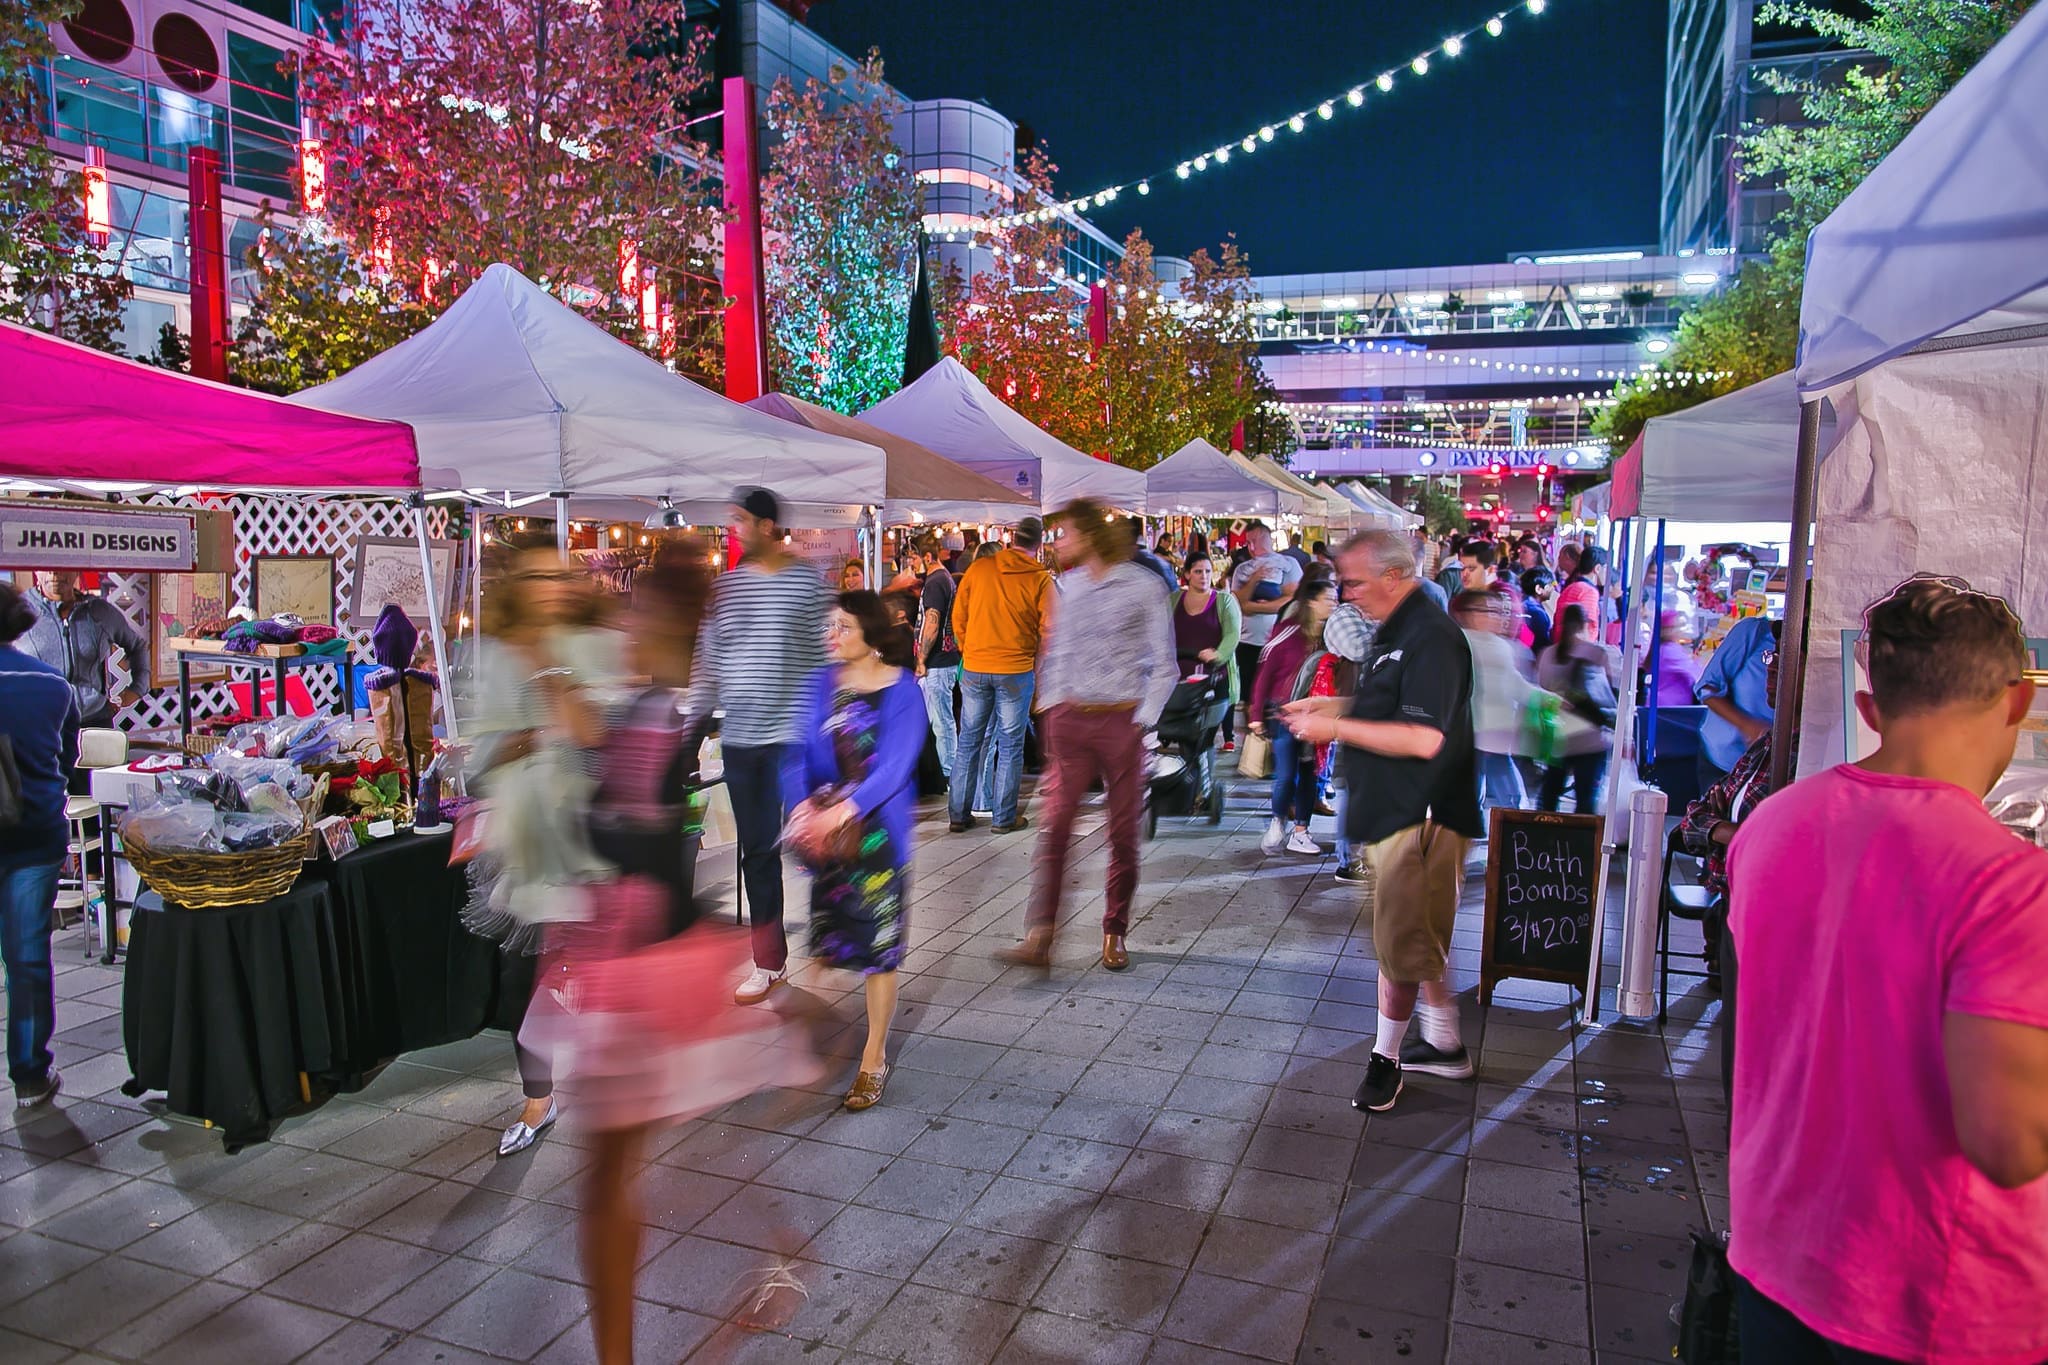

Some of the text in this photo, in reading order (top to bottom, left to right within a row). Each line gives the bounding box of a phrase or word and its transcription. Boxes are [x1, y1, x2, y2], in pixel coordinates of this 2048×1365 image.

[1450, 450, 1549, 466] PARKING
[17, 530, 177, 552] JHARI DESIGNS
[1512, 830, 1582, 877] Bath
[1504, 872, 1588, 905] Bombs
